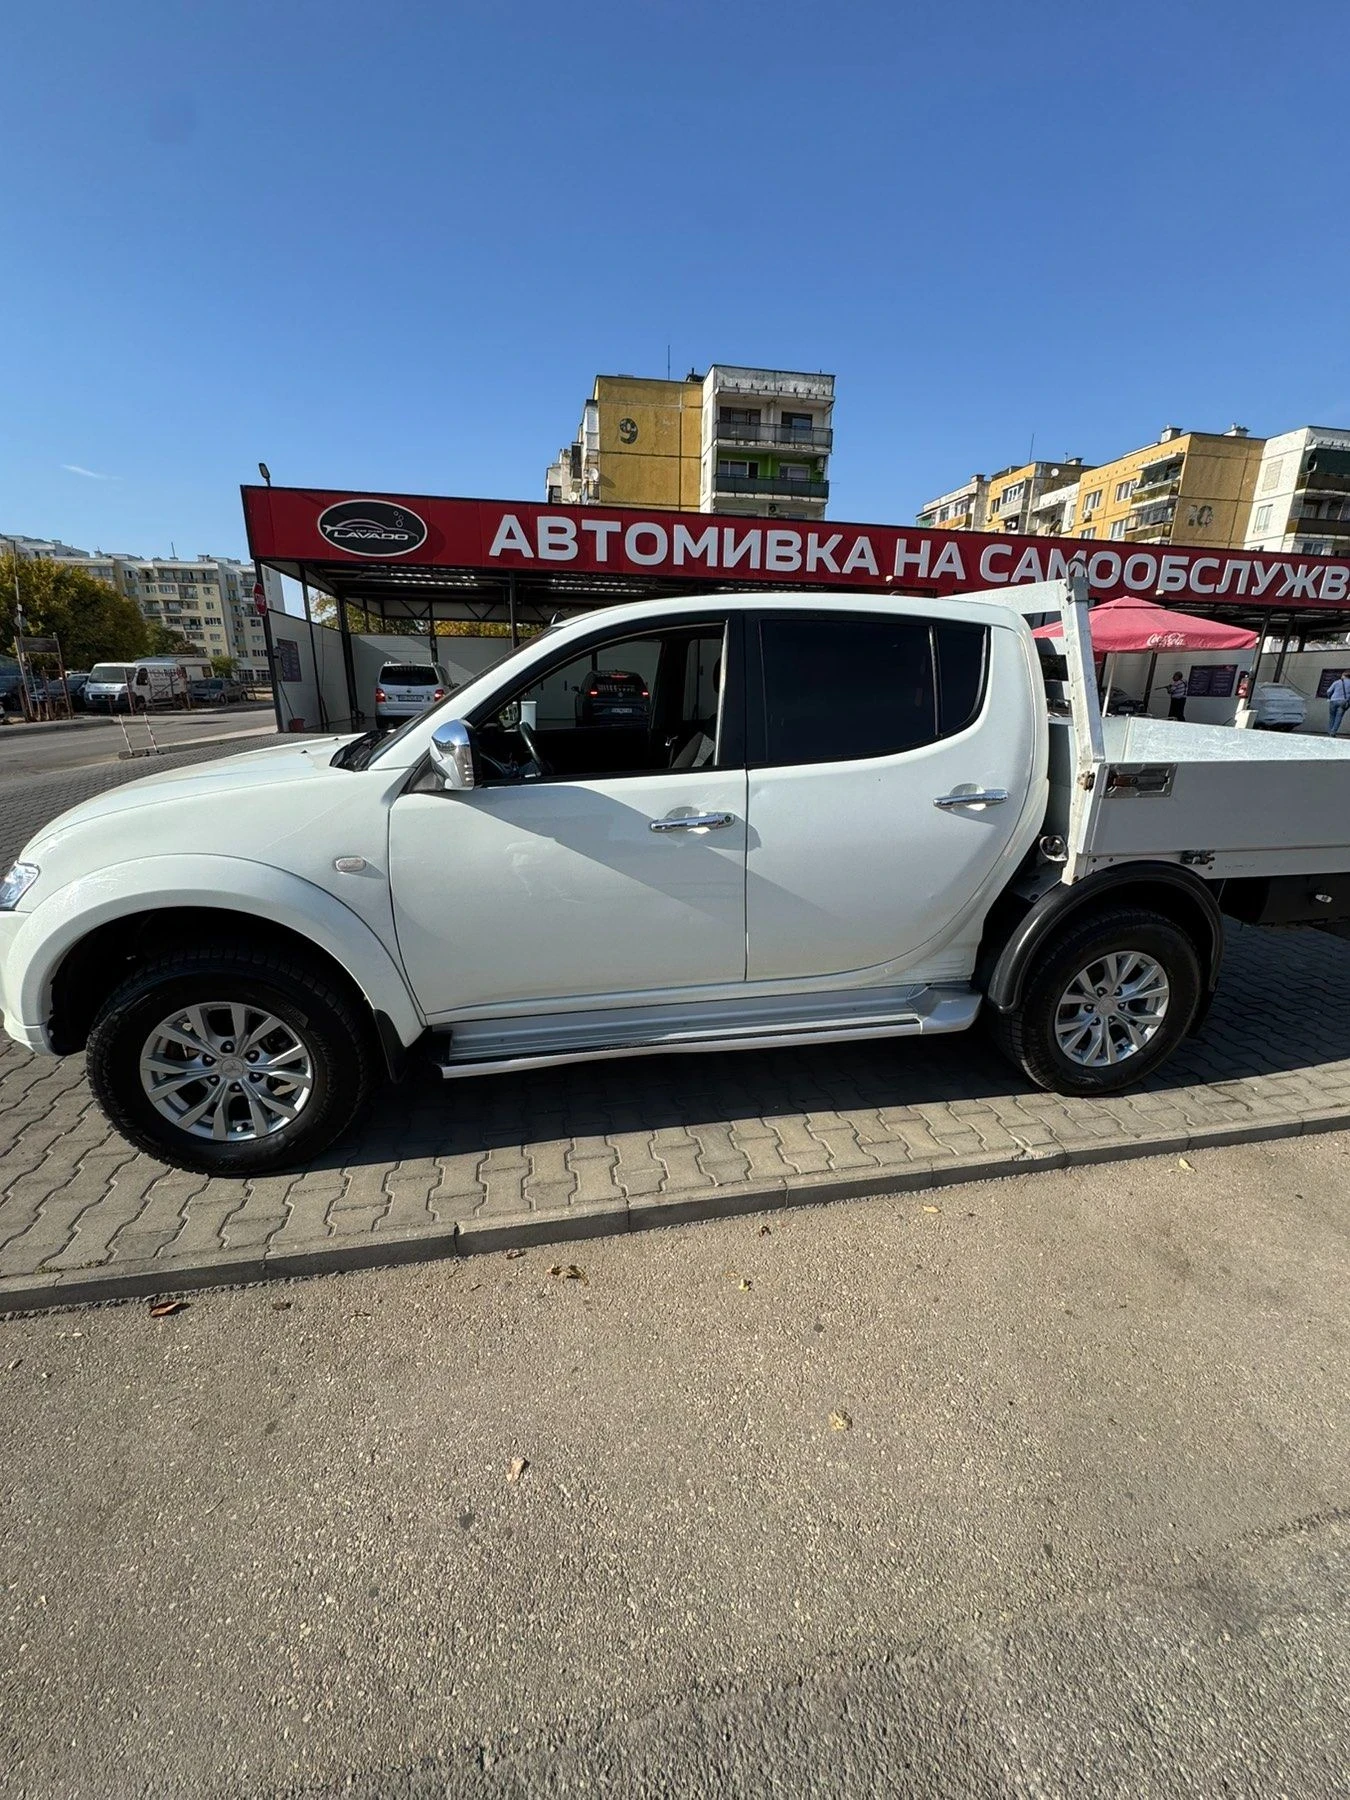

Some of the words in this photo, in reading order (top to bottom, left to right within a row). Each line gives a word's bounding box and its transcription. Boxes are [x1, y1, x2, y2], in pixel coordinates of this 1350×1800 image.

[619, 417, 639, 445] 9
[333, 531, 409, 541] LAVADO
[488, 513, 880, 577] АВТОМИВКА
[893, 538, 967, 581] НА
[979, 543, 1350, 601] САМООБСЛУЖВ
